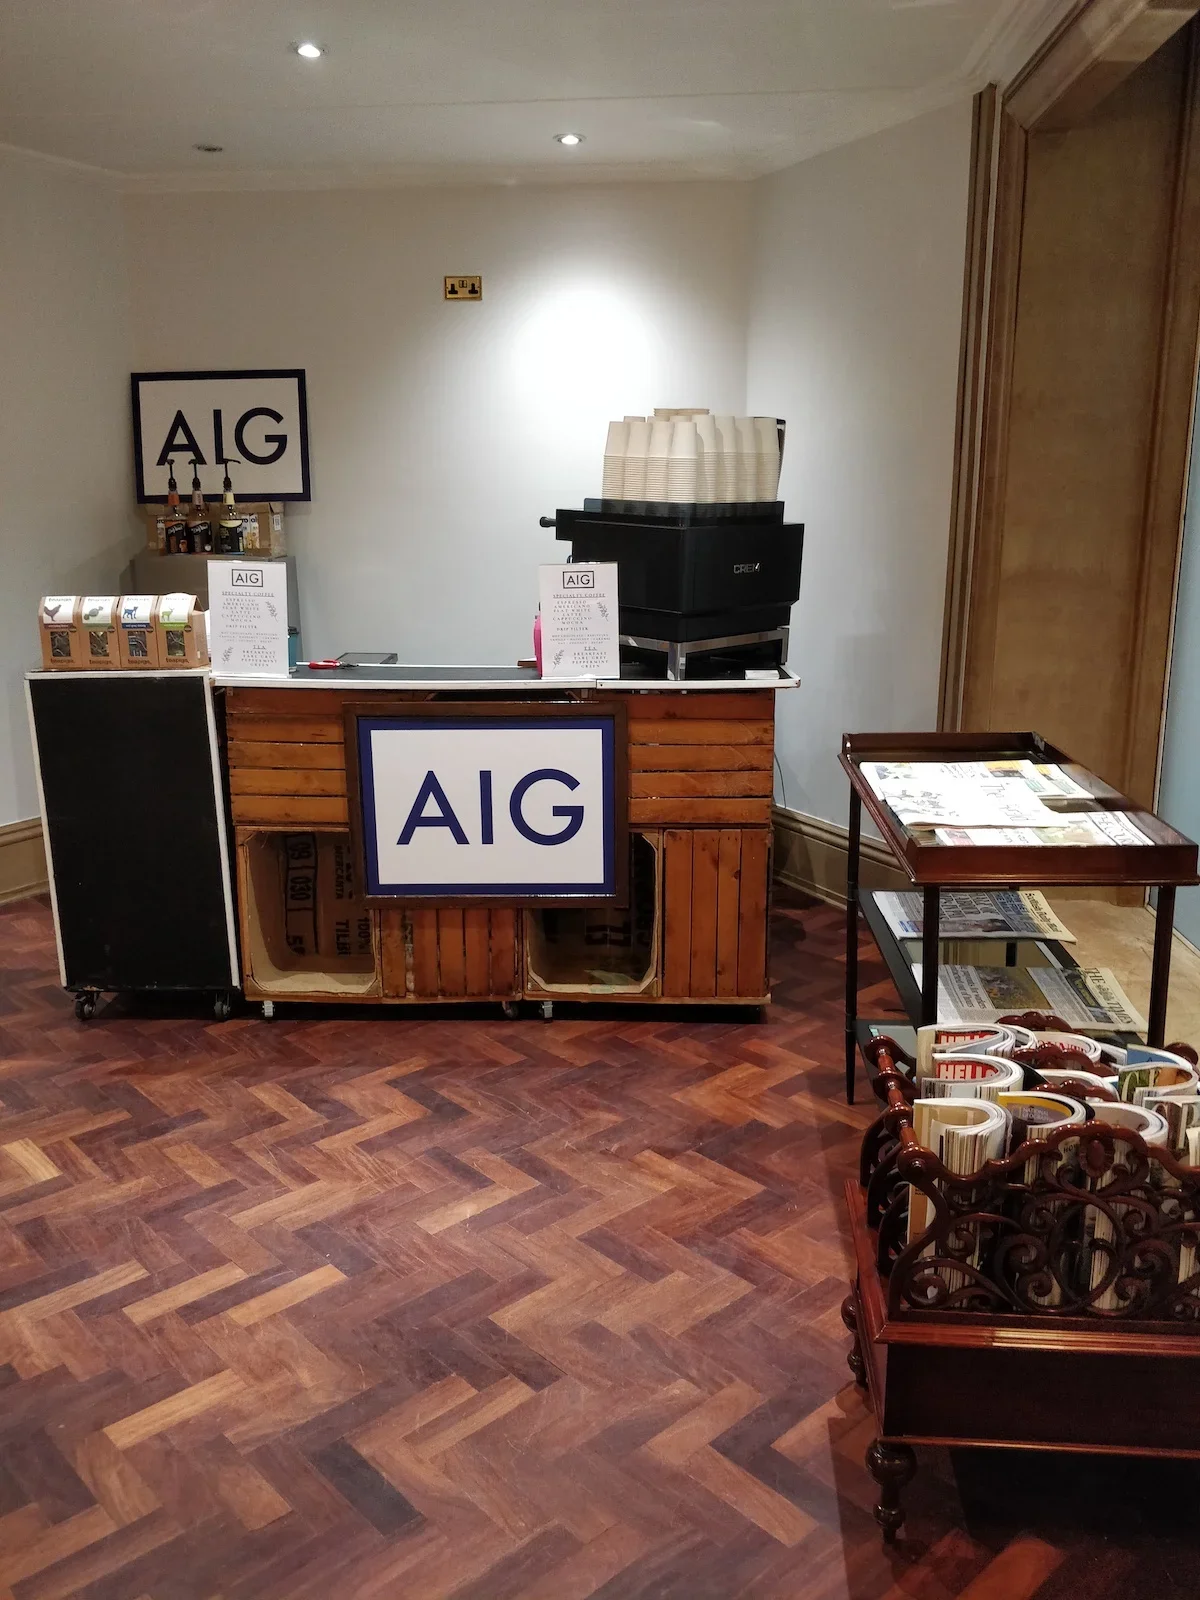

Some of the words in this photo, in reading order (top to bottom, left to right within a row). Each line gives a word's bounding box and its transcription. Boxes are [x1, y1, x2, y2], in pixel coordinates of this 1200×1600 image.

[156, 407, 288, 466] AIG
[235, 573, 259, 584] AIG
[566, 574, 590, 586] AIG
[396, 768, 585, 846] AIG
[1084, 968, 1106, 984] THE
[1106, 1001, 1136, 1025] TIMES
